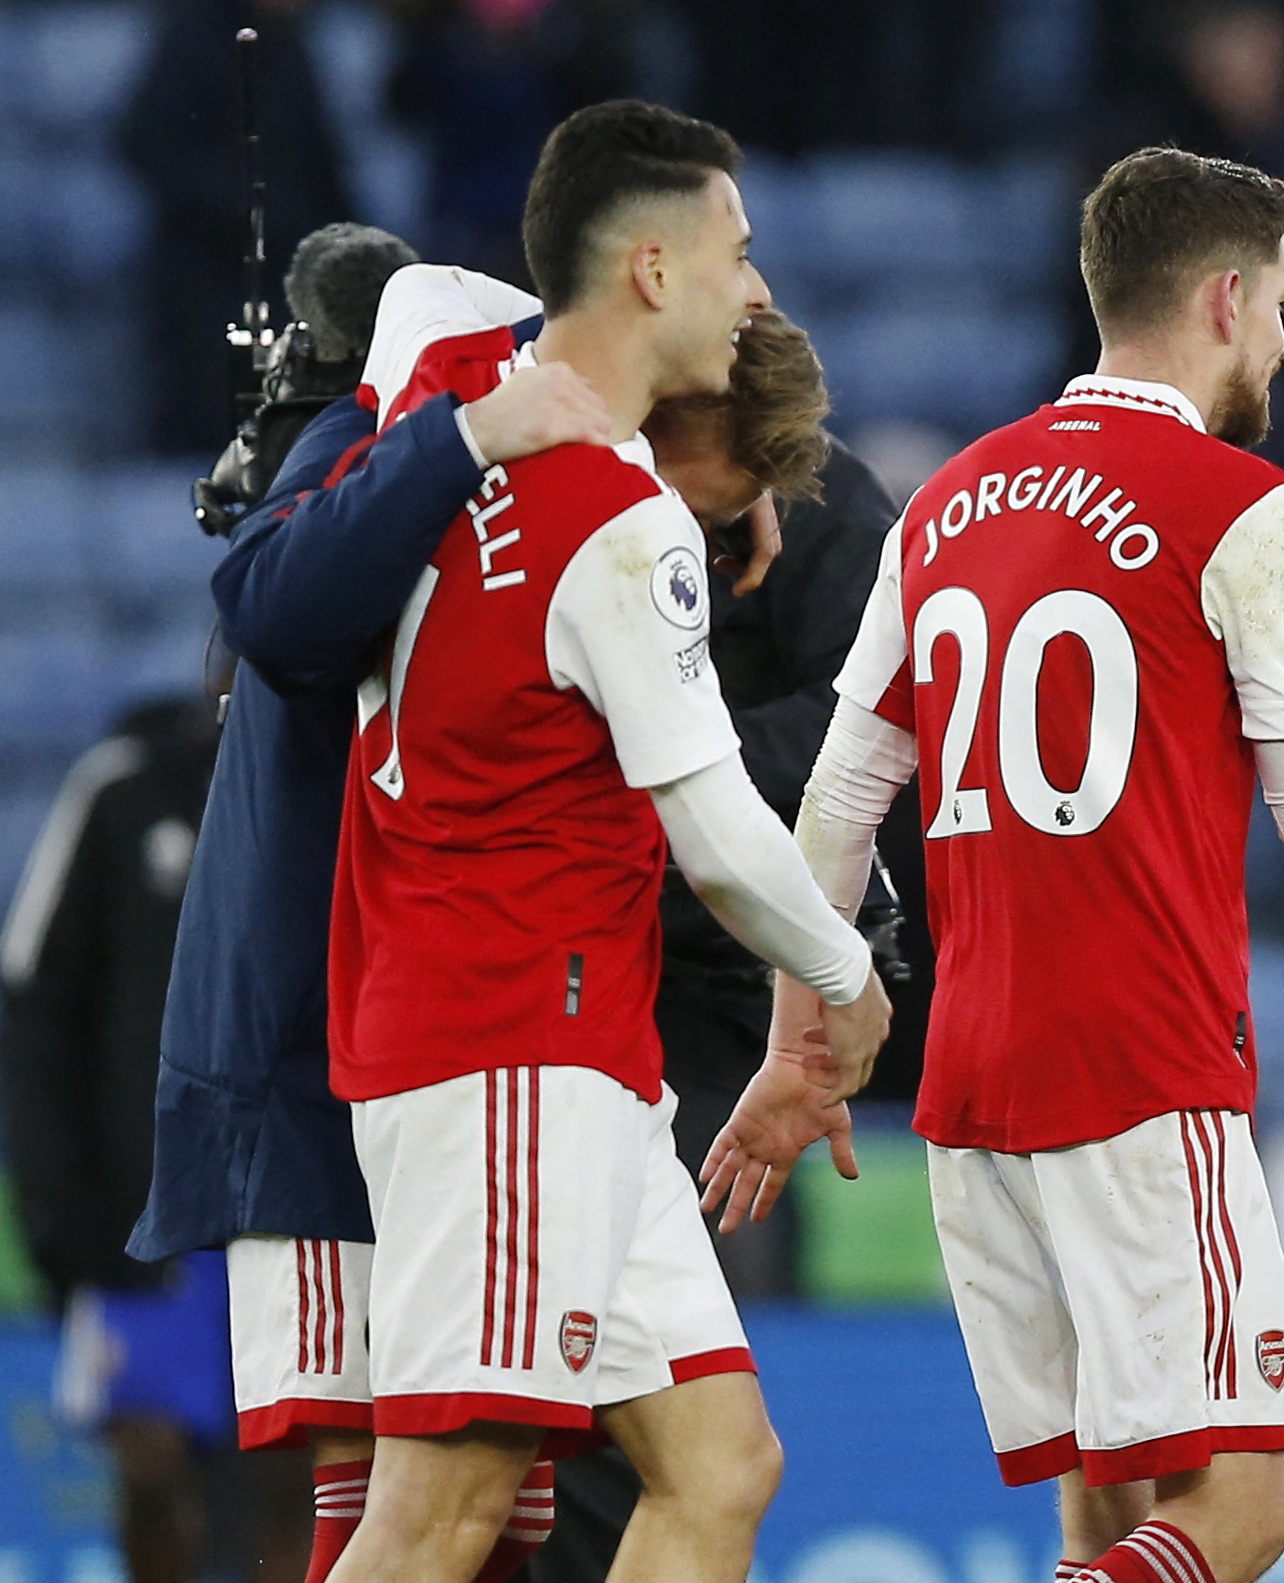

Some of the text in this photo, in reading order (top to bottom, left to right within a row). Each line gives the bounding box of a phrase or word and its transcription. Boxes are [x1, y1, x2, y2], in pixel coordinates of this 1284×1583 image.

[1047, 420, 1101, 432] ARSENAL
[922, 465, 1161, 571] JORGINHO
[913, 586, 1138, 840] 20
